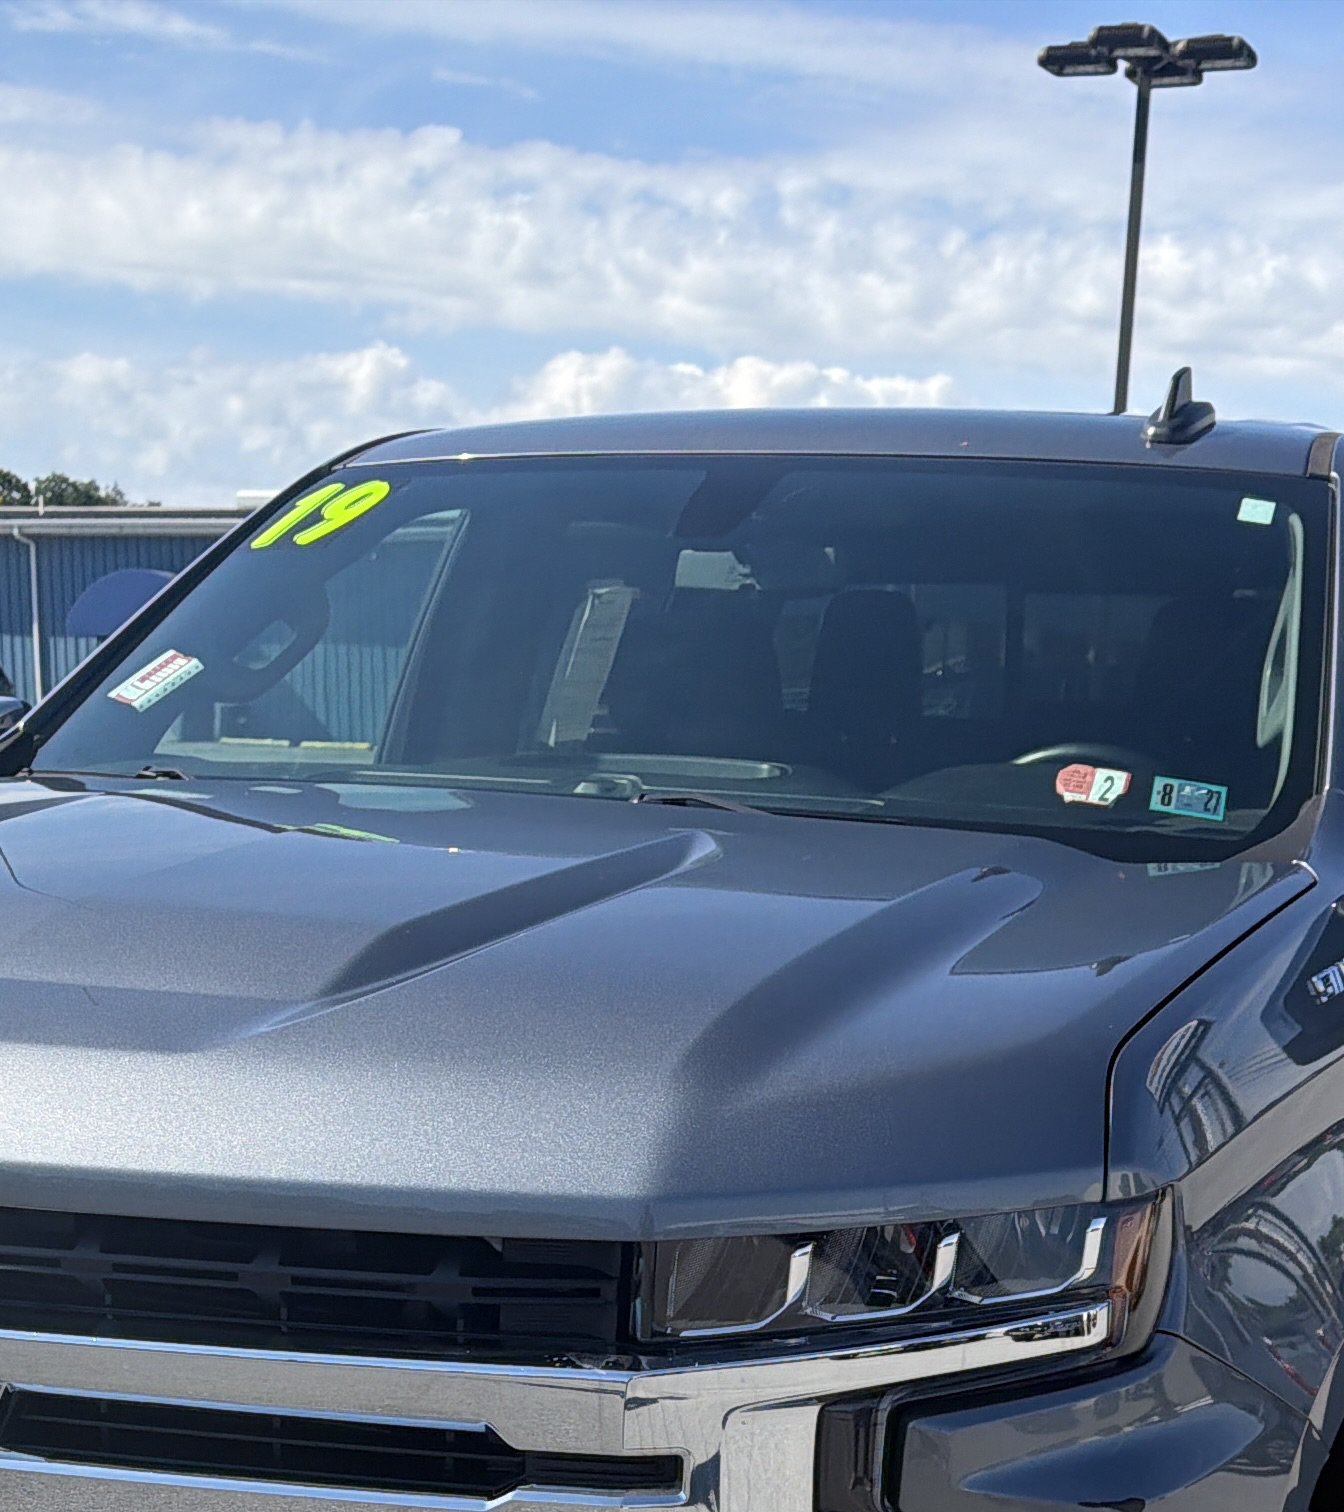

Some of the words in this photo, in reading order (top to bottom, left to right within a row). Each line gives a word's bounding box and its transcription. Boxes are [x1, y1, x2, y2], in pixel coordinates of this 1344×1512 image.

[250, 479, 391, 549] 19
[1097, 775, 1115, 802] 2
[1160, 782, 1174, 807] 8
[1203, 789, 1222, 816] 27
